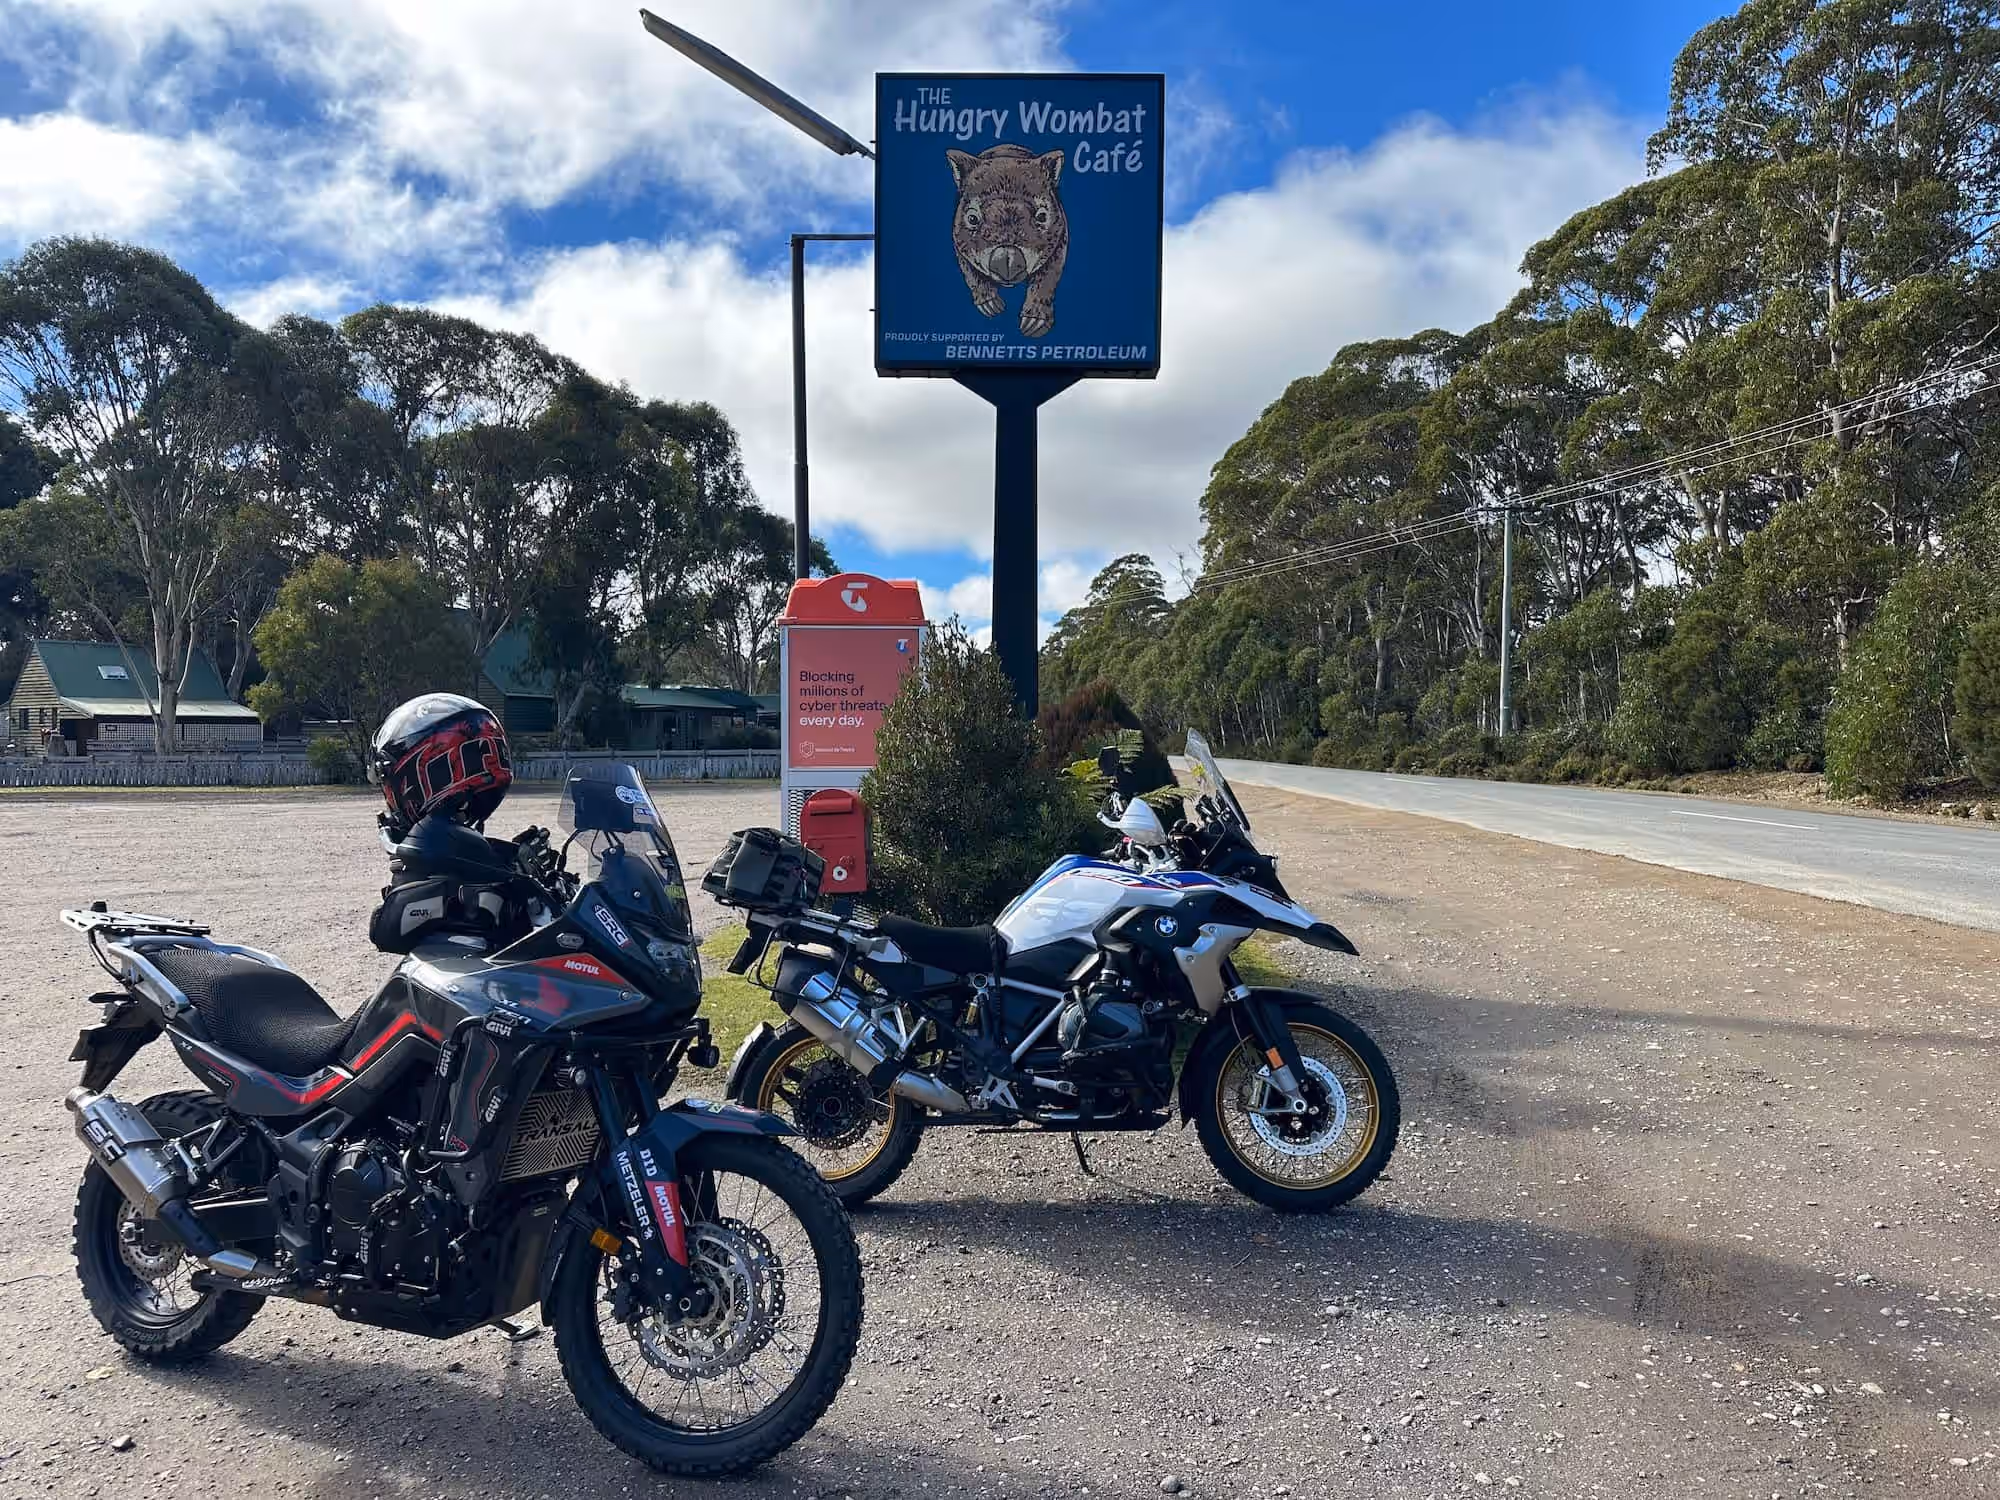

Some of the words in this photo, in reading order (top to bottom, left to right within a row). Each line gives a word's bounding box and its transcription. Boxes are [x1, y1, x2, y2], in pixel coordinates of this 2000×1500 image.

[917, 87, 952, 105] THE
[894, 98, 1009, 140] Hungry
[1019, 101, 1146, 134] Wombat
[1073, 140, 1144, 173] Café
[884, 332, 929, 342] PROUDLY
[931, 333, 989, 342] SUPPORTED
[991, 334, 1005, 342] BY
[945, 345, 1036, 359] BENNETTS
[1041, 346, 1147, 359] PETROLEUM
[800, 671, 855, 684] Blocking
[800, 685, 848, 696] millions
[851, 685, 865, 696] of
[800, 701, 837, 712] cyber
[800, 716, 836, 727] every
[838, 715, 865, 727] day.
[564, 960, 600, 975] MOTUL
[486, 1021, 512, 1037] GIVI
[439, 1049, 452, 1077] GIVI
[485, 1095, 501, 1123] GIVI
[617, 1150, 650, 1228] METZELER
[654, 1185, 676, 1227] MOTUL
